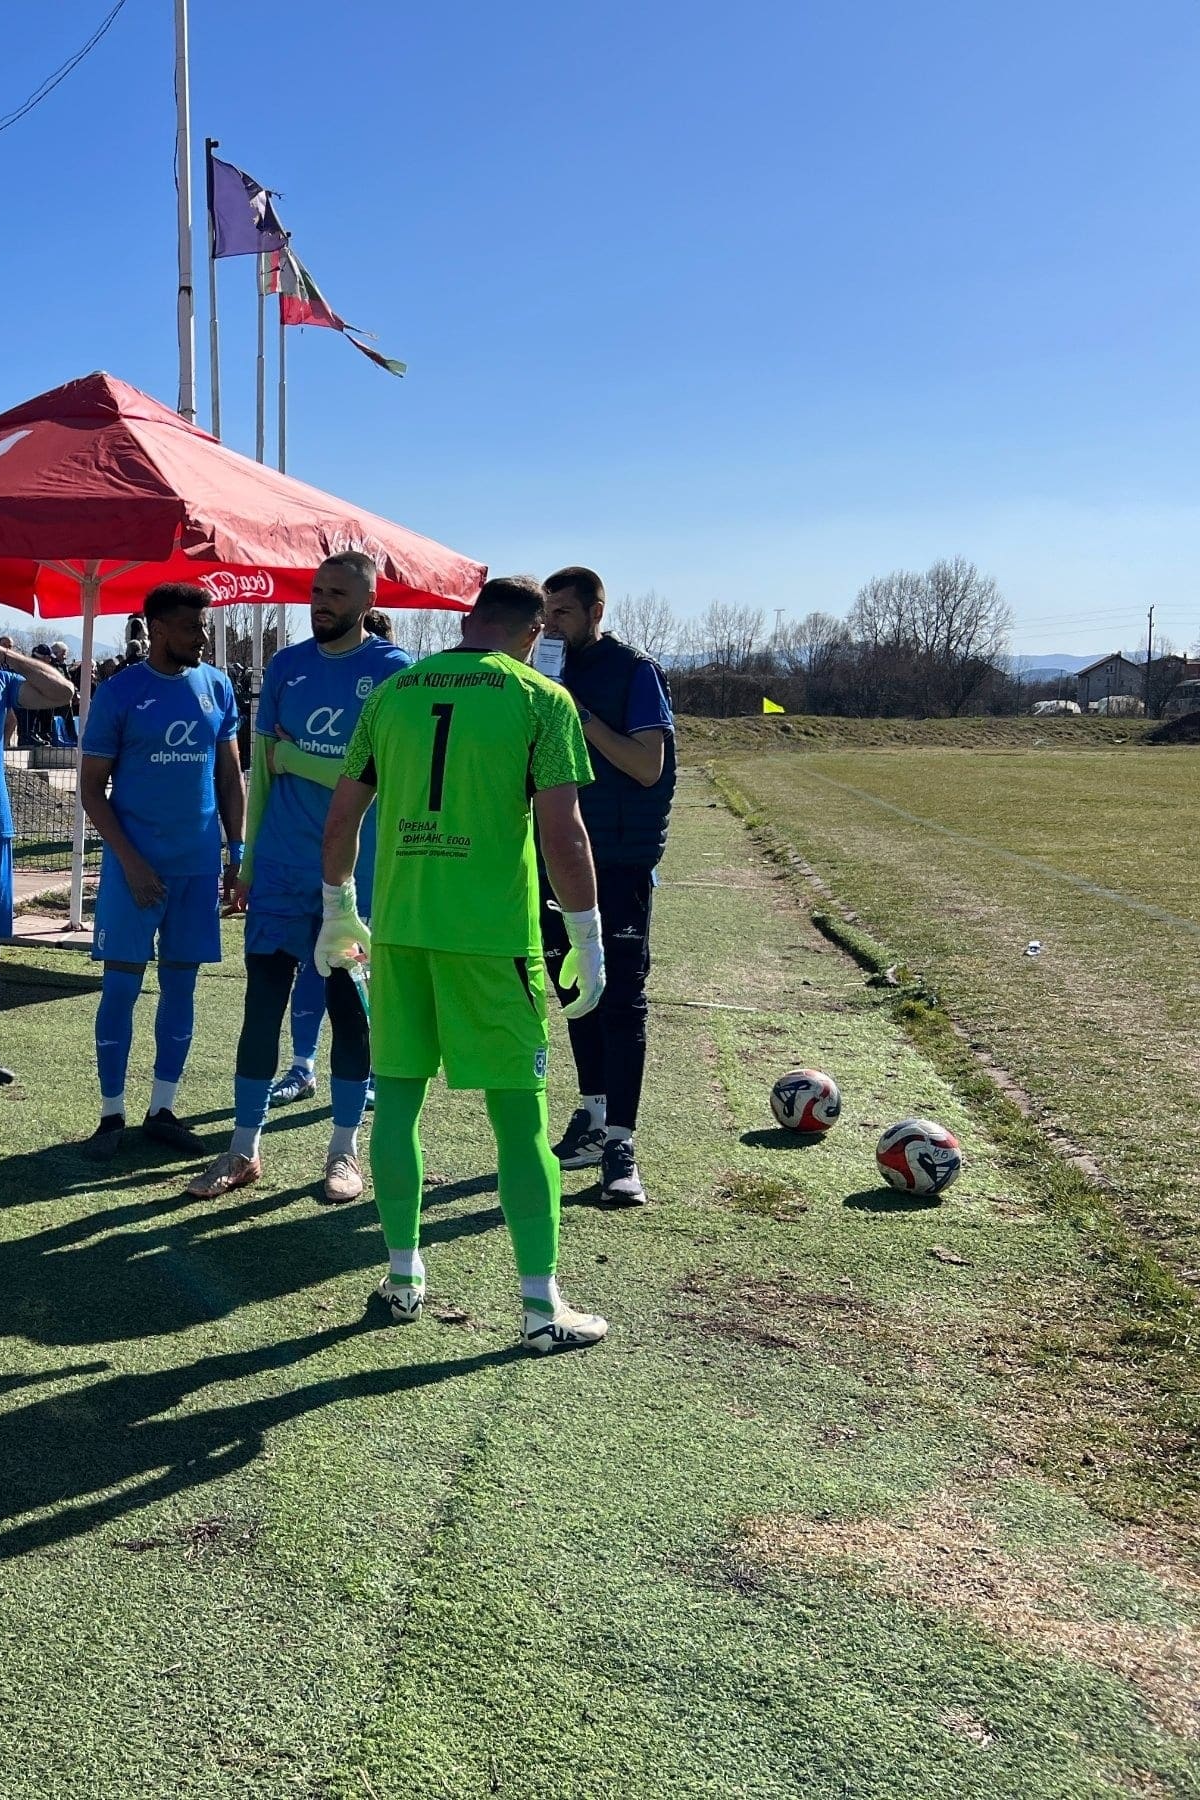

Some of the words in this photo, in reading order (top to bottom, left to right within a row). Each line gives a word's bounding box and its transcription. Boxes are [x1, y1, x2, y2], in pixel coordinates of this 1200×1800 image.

[423, 671, 506, 689] КОСТИНБРОД
[296, 739, 346, 755] lphawi
[151, 751, 208, 765] alphawin
[429, 703, 454, 811] 1
